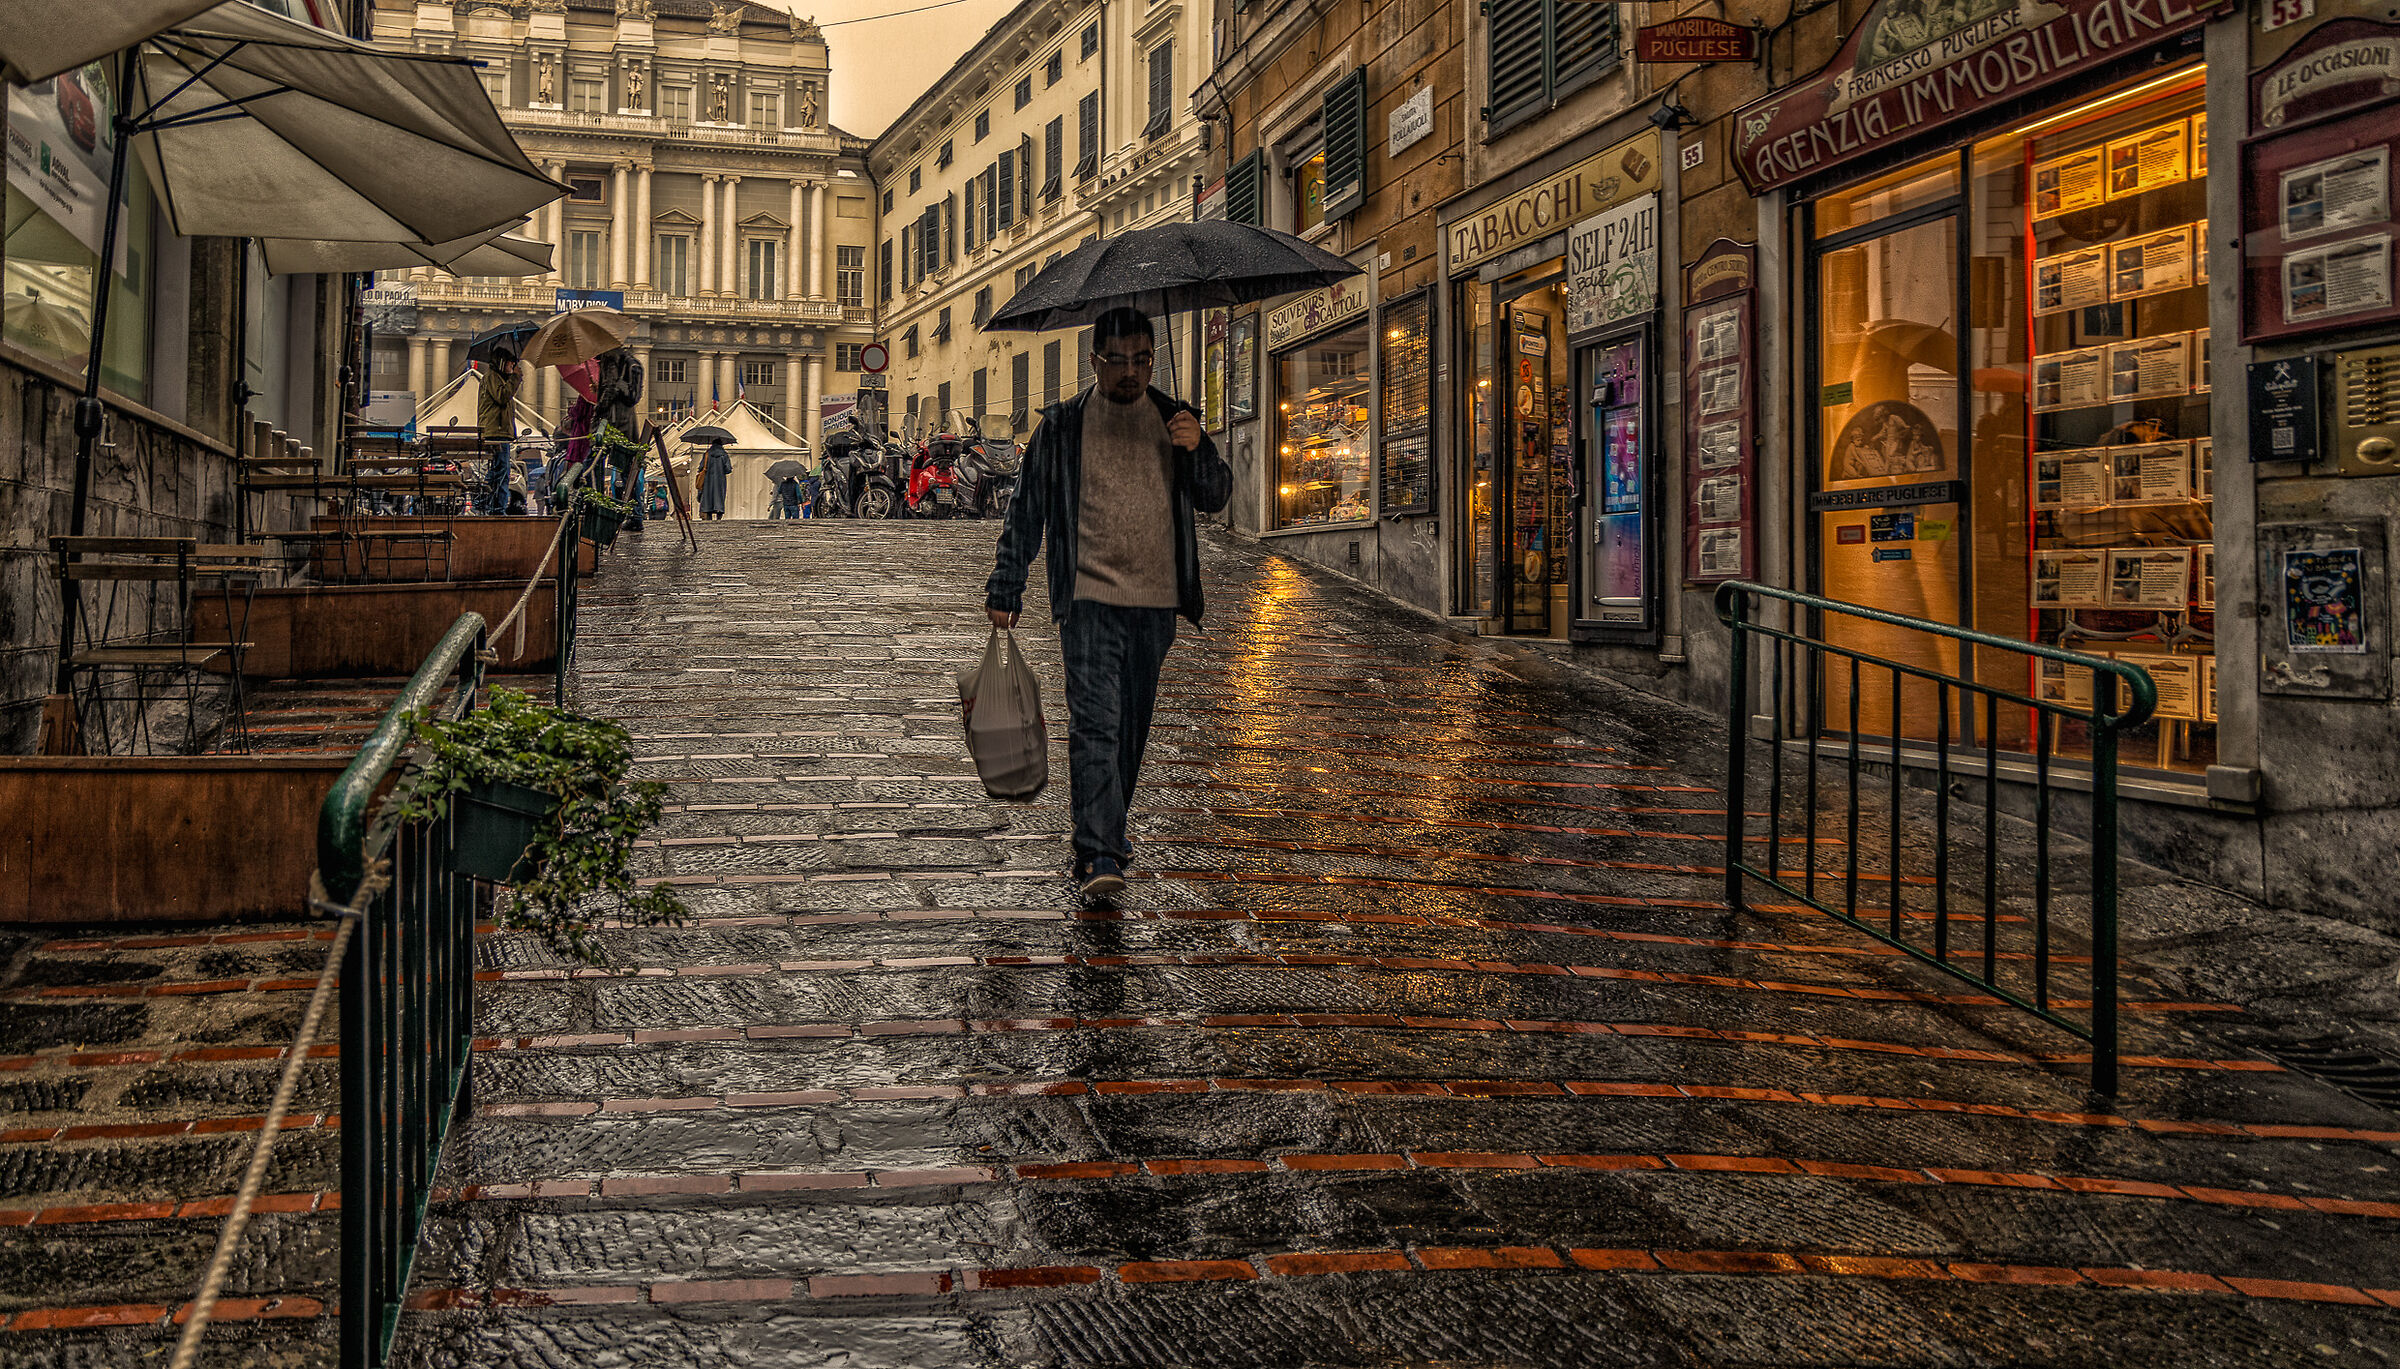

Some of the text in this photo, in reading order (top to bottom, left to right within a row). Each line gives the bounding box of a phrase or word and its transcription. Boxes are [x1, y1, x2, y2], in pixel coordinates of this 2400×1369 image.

[2272, 0, 2302, 26] 53
[1656, 20, 1736, 37] IMMOBILIARE
[1651, 41, 1741, 56] PUGLIESE
[1848, 8, 2022, 100] FRANCESCO PUGLIESE
[2278, 47, 2391, 97] LE OCCASIONI
[1756, 97, 1889, 182] AGENZIA
[1685, 147, 1699, 166] 55
[1456, 173, 1582, 261] TABACCHI
[1572, 207, 1654, 276] SELF 24H
[557, 299, 584, 311] MOBY
[1272, 292, 1325, 328] SOUVENIRS
[824, 409, 853, 425] BONJOUR
[1887, 485, 1947, 501] PUGLIESE
